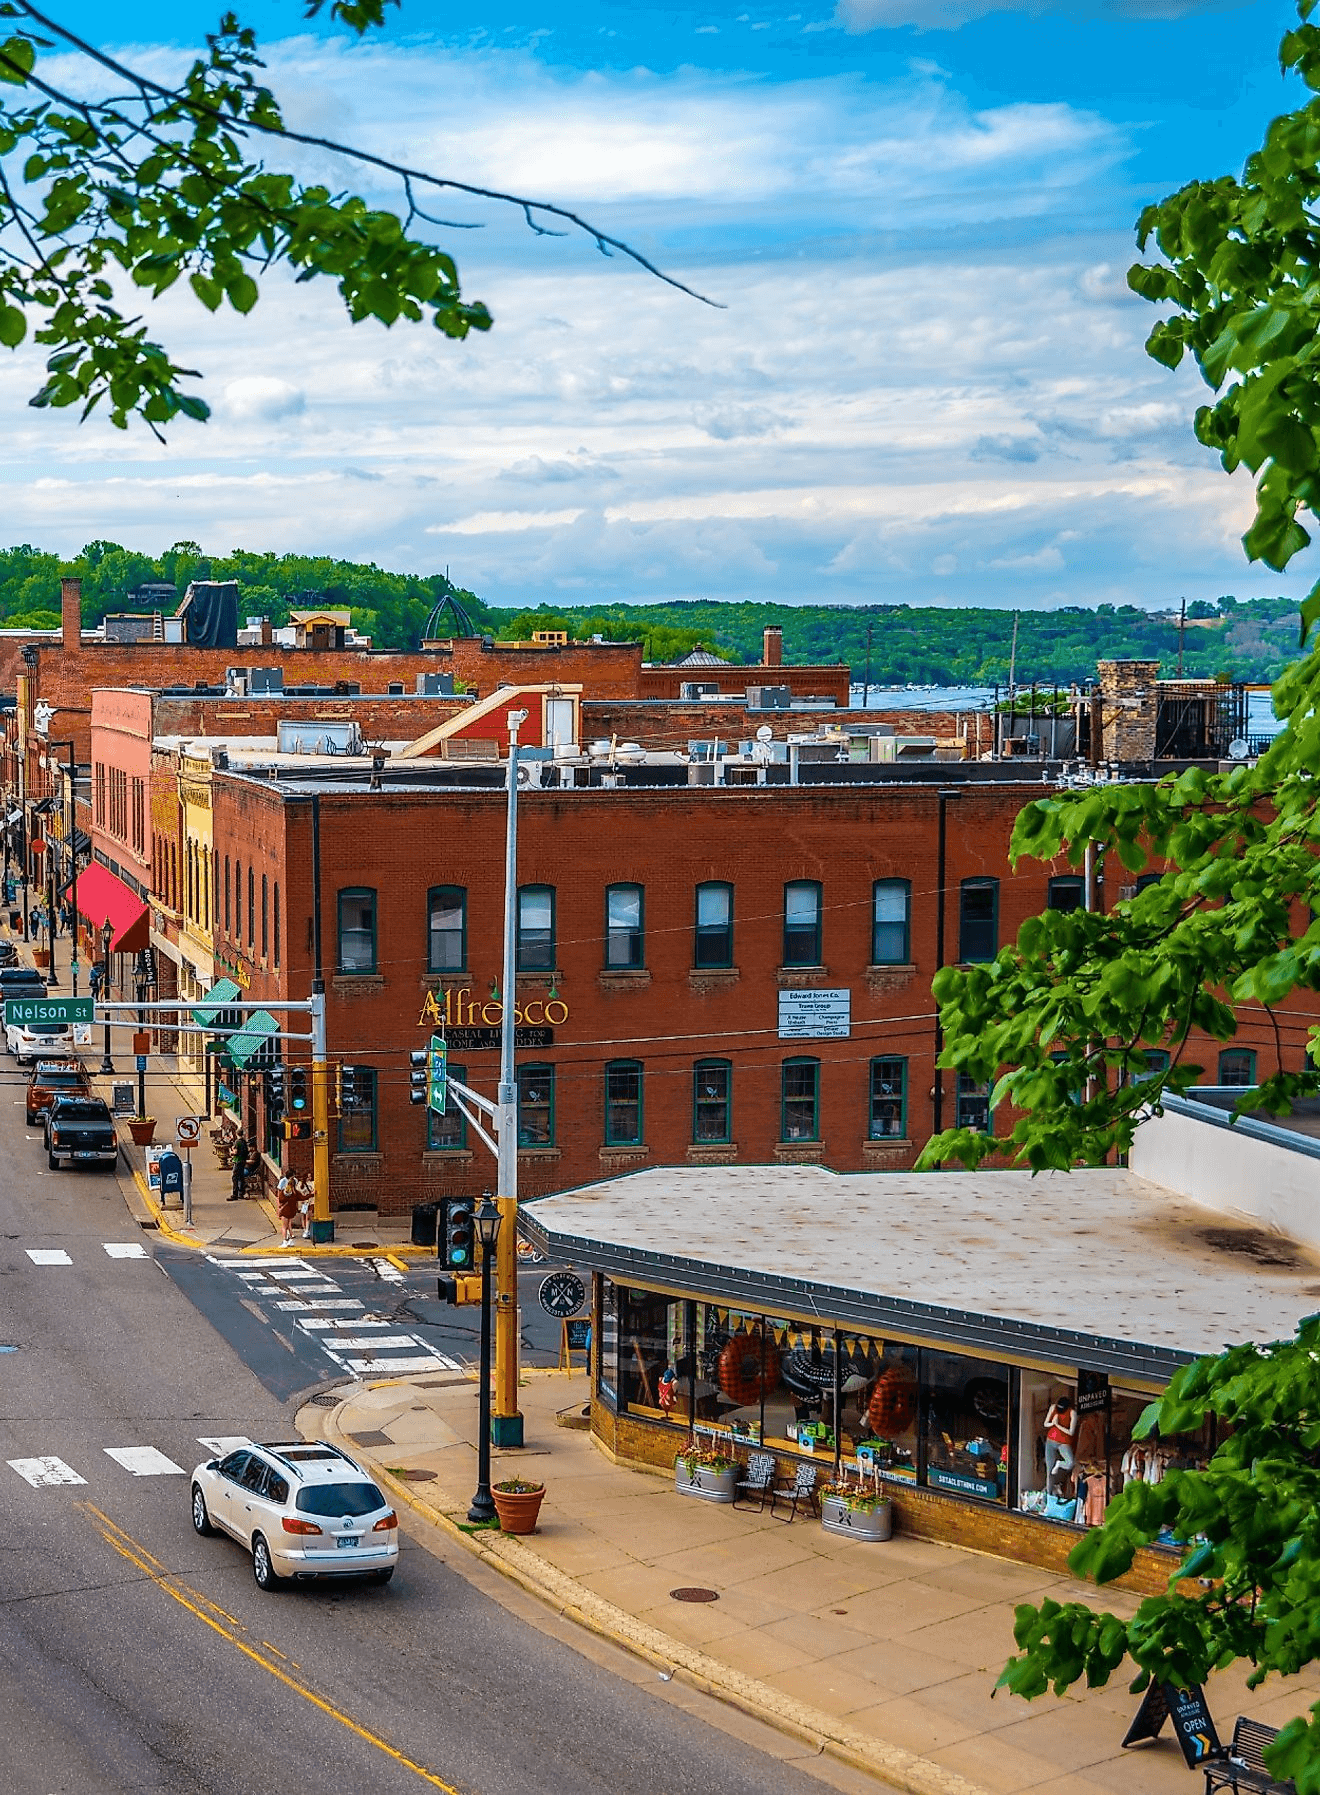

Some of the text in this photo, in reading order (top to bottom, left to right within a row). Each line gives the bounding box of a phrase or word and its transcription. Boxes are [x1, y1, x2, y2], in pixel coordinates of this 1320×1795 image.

[12, 1004, 87, 1019] Nelson St
[416, 987, 569, 1026] Alfresco
[444, 1029, 483, 1039] CASUAL
[489, 1029, 524, 1039] LIG
[446, 1039, 475, 1048] HOME
[551, 1287, 574, 1296] M N
[1078, 1389, 1107, 1403] UNPAVED
[1183, 1716, 1207, 1733] OPEN
